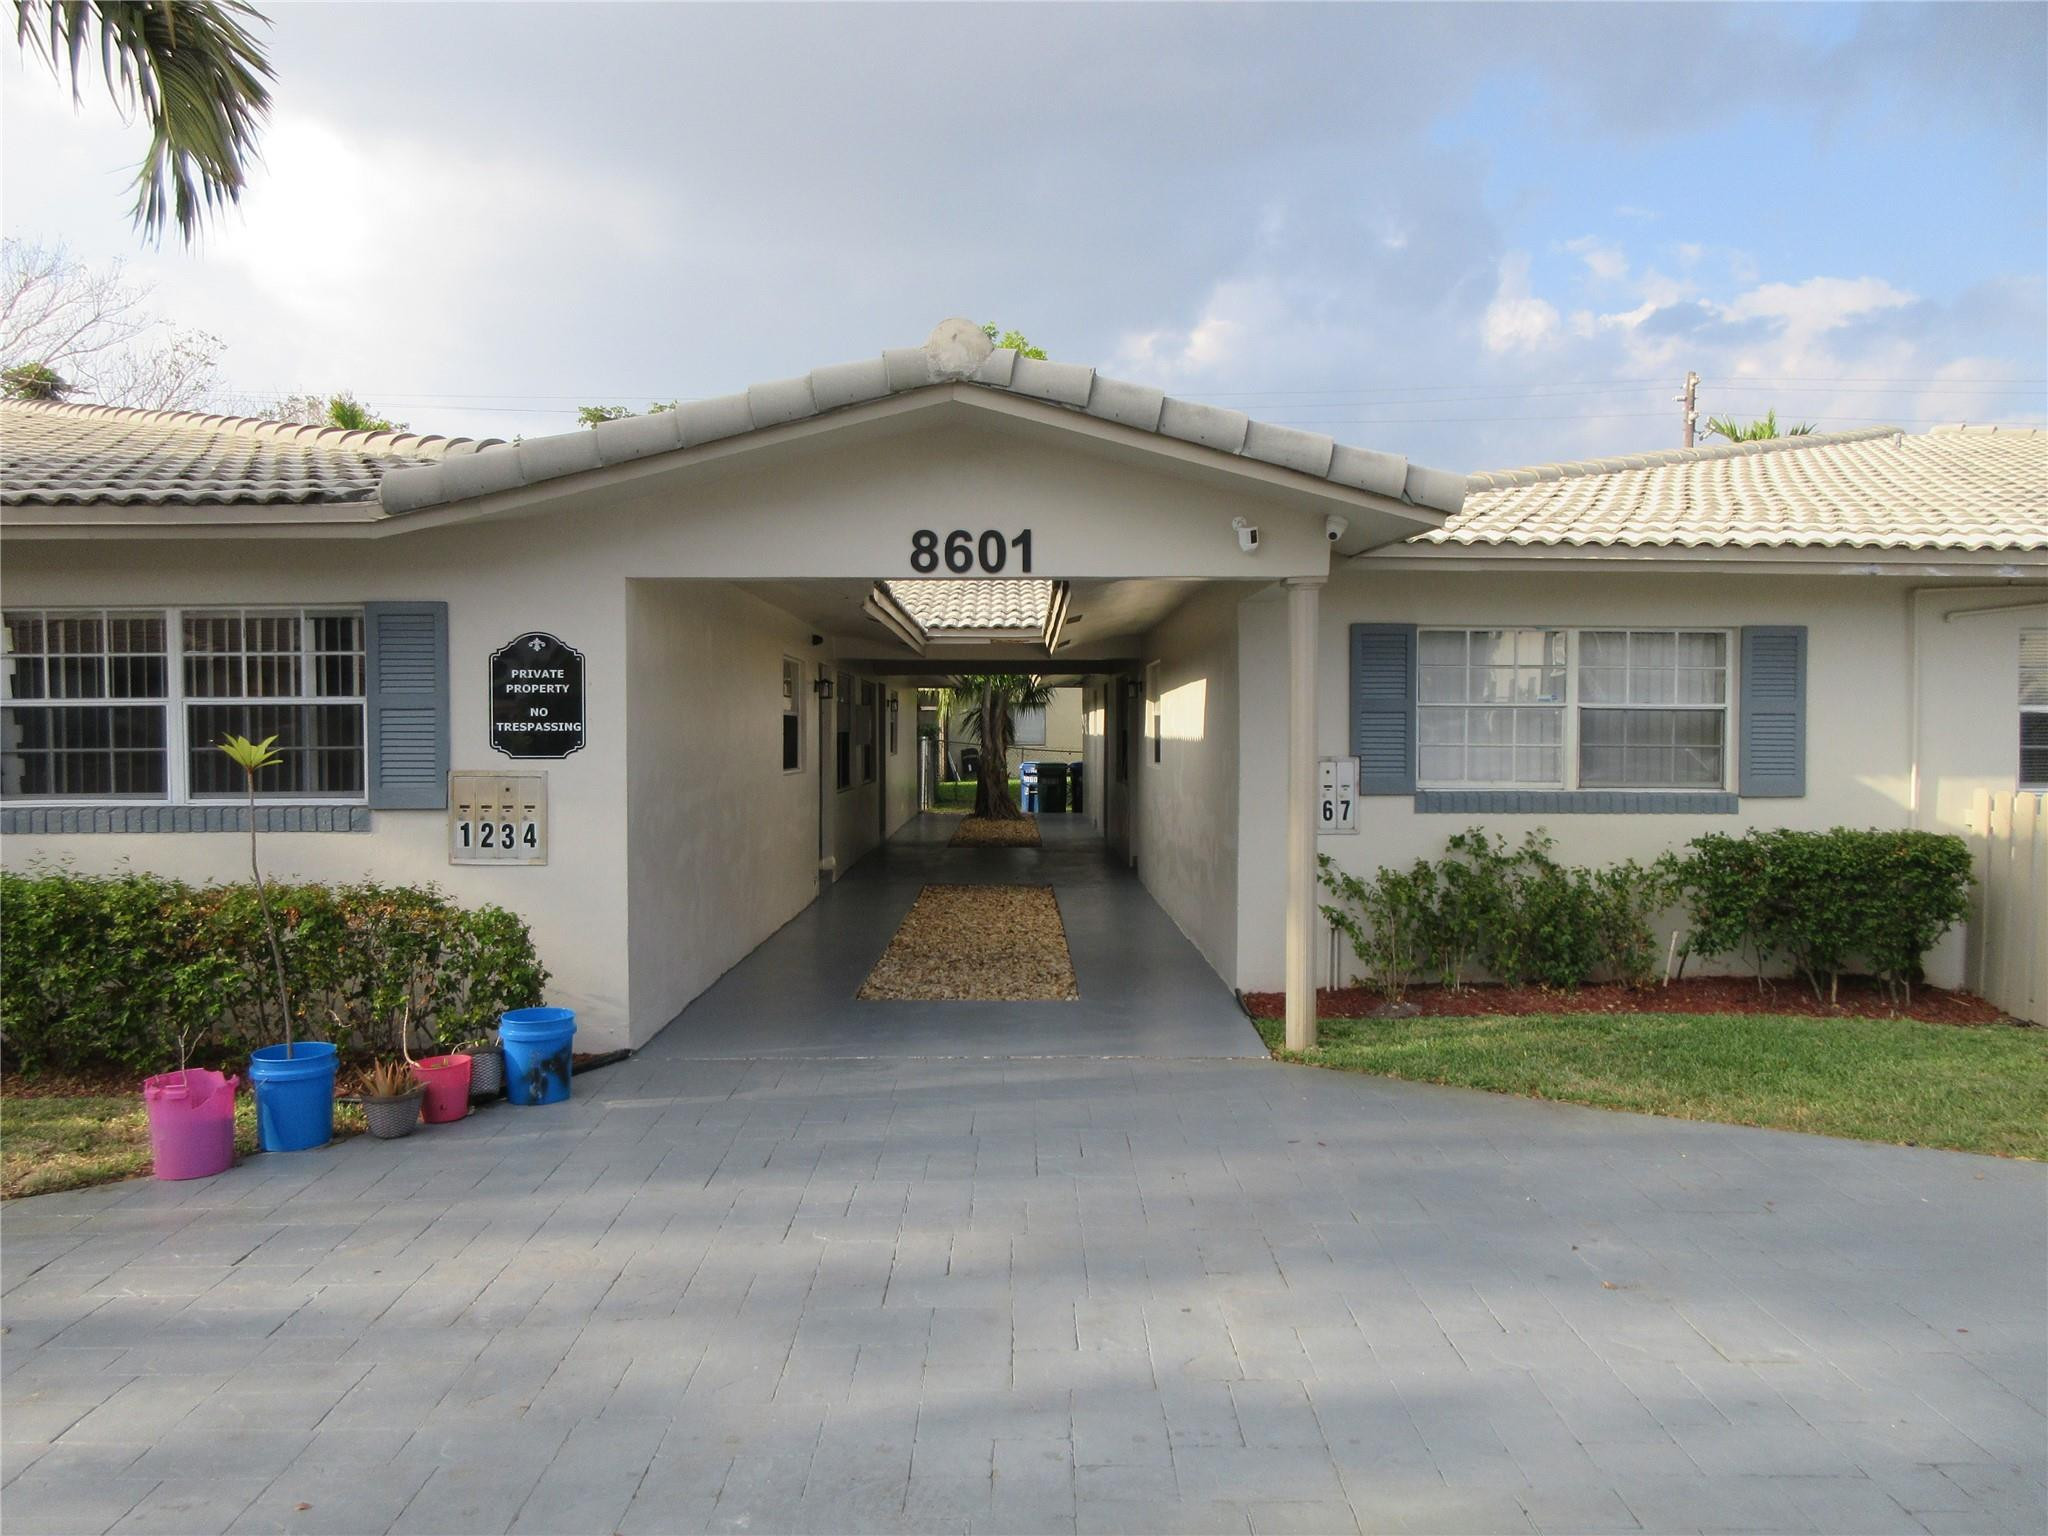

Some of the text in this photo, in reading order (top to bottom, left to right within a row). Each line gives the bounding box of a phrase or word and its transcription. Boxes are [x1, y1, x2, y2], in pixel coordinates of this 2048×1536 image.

[910, 528, 1032, 573] 8601
[511, 669, 565, 679] PRIVATE
[506, 684, 570, 694] PROPERTY
[530, 707, 549, 717] NO
[496, 722, 581, 732] TRESPASSING
